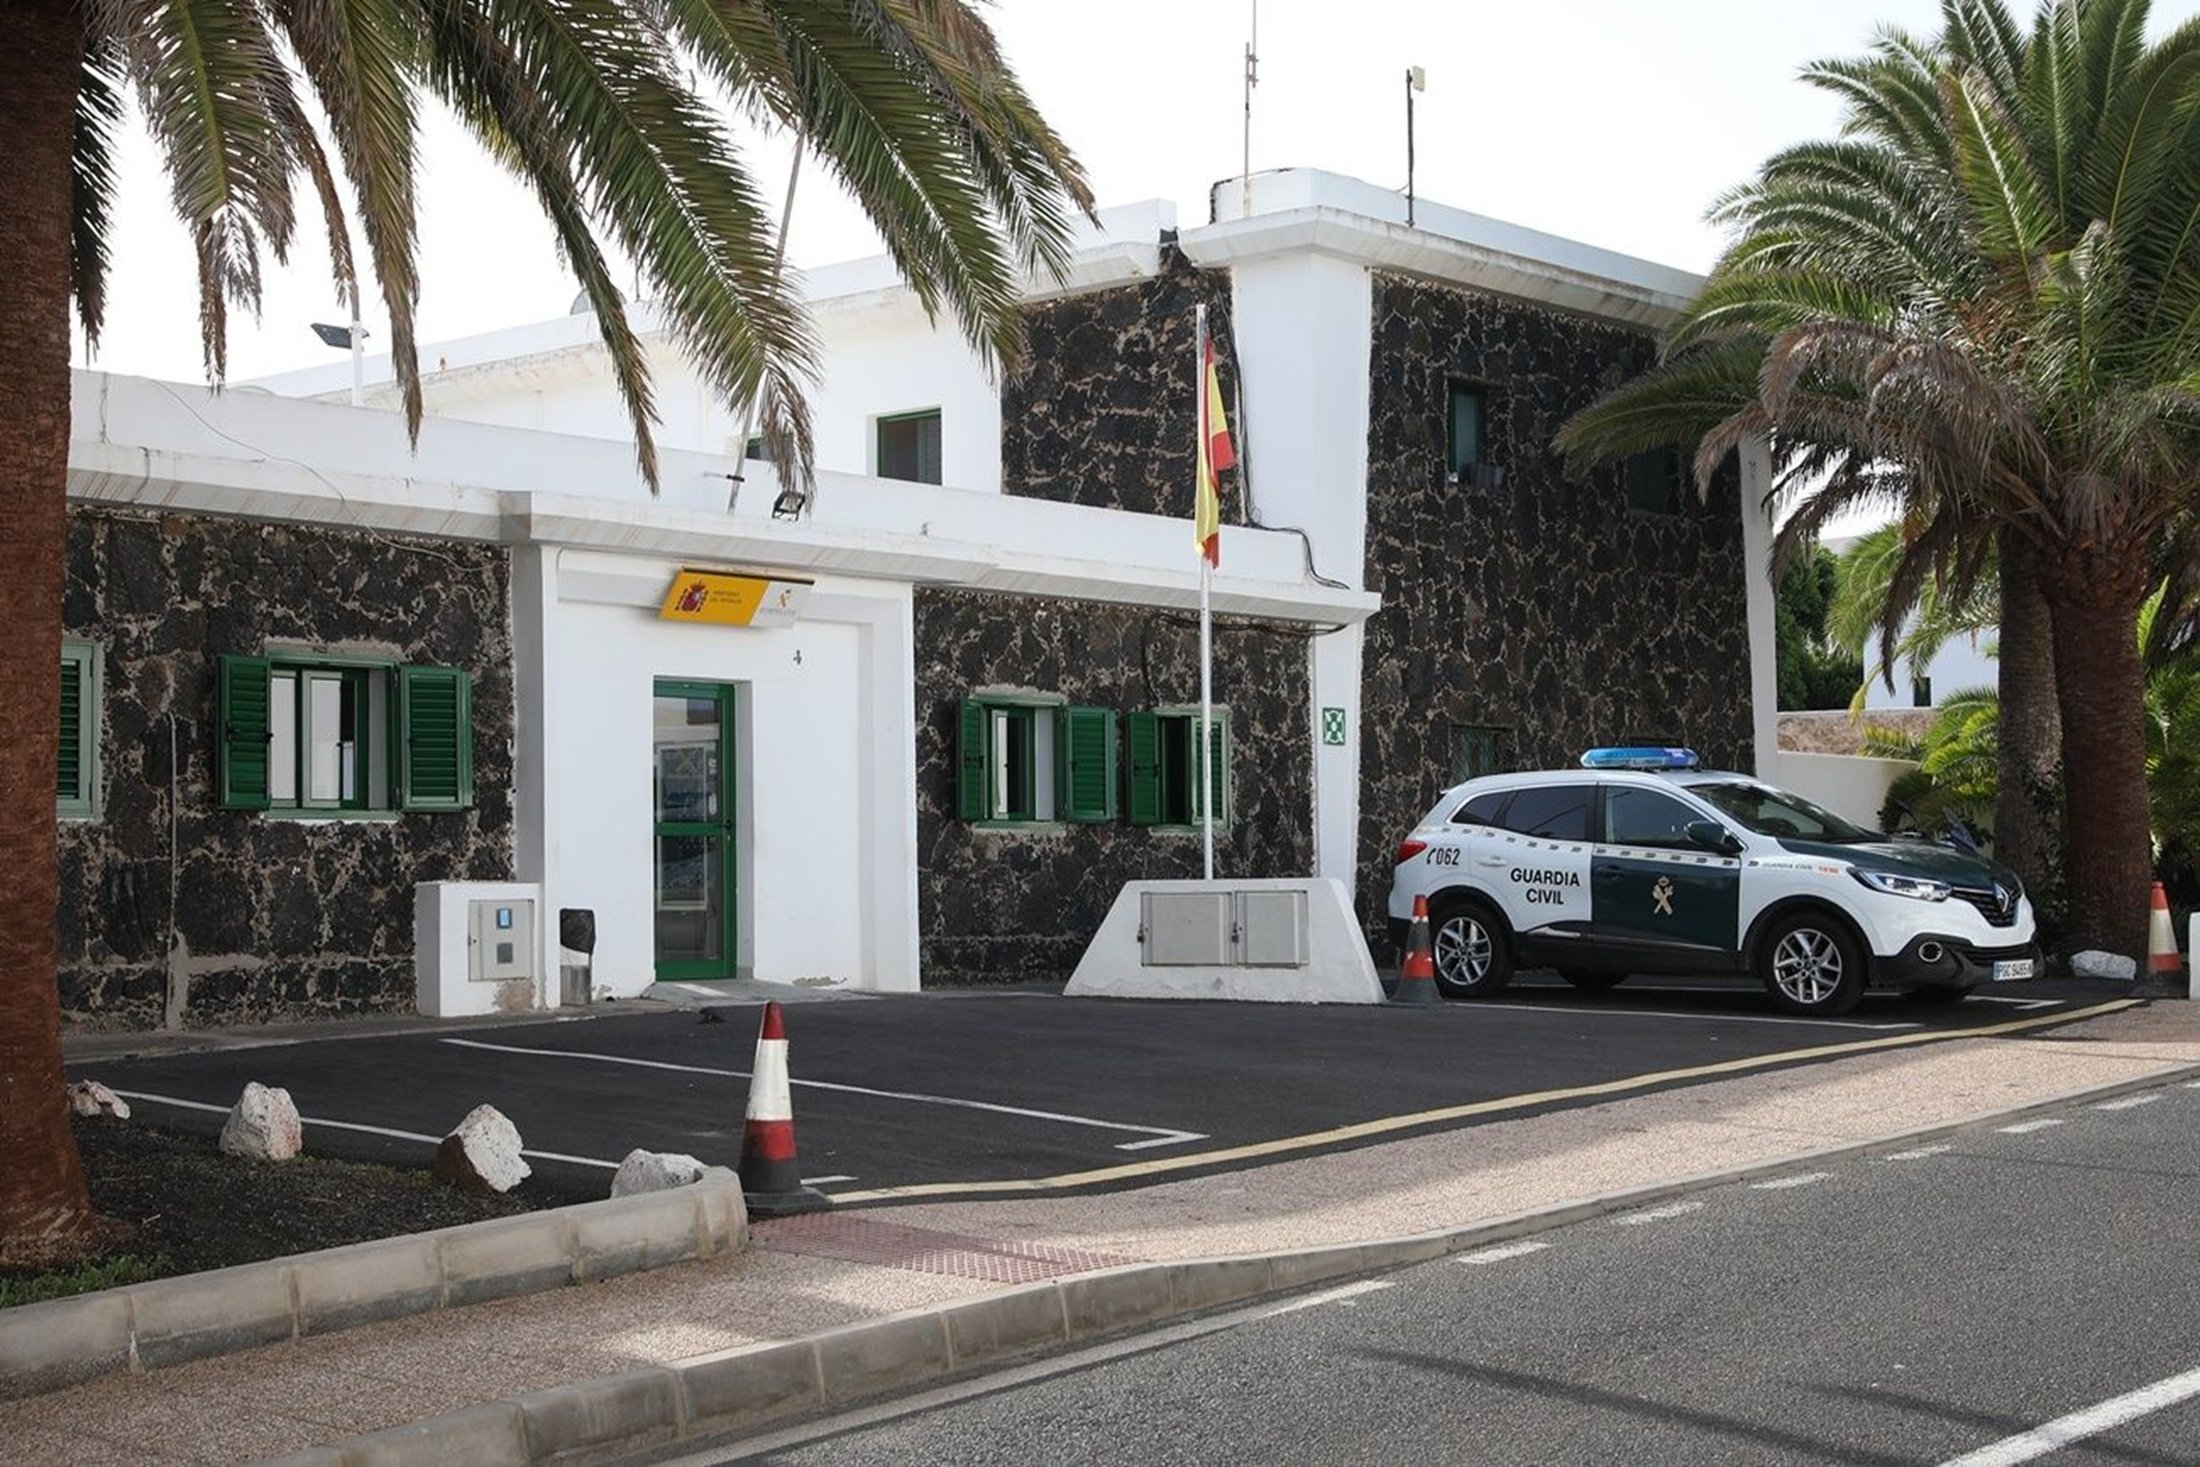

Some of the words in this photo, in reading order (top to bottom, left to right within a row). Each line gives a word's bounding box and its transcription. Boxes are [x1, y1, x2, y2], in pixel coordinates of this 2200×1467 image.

[793, 650, 802, 665] 4
[1436, 848, 1461, 866] 062
[1510, 868, 1580, 887] GUARDIA
[1526, 888, 1564, 905] CIVIL
